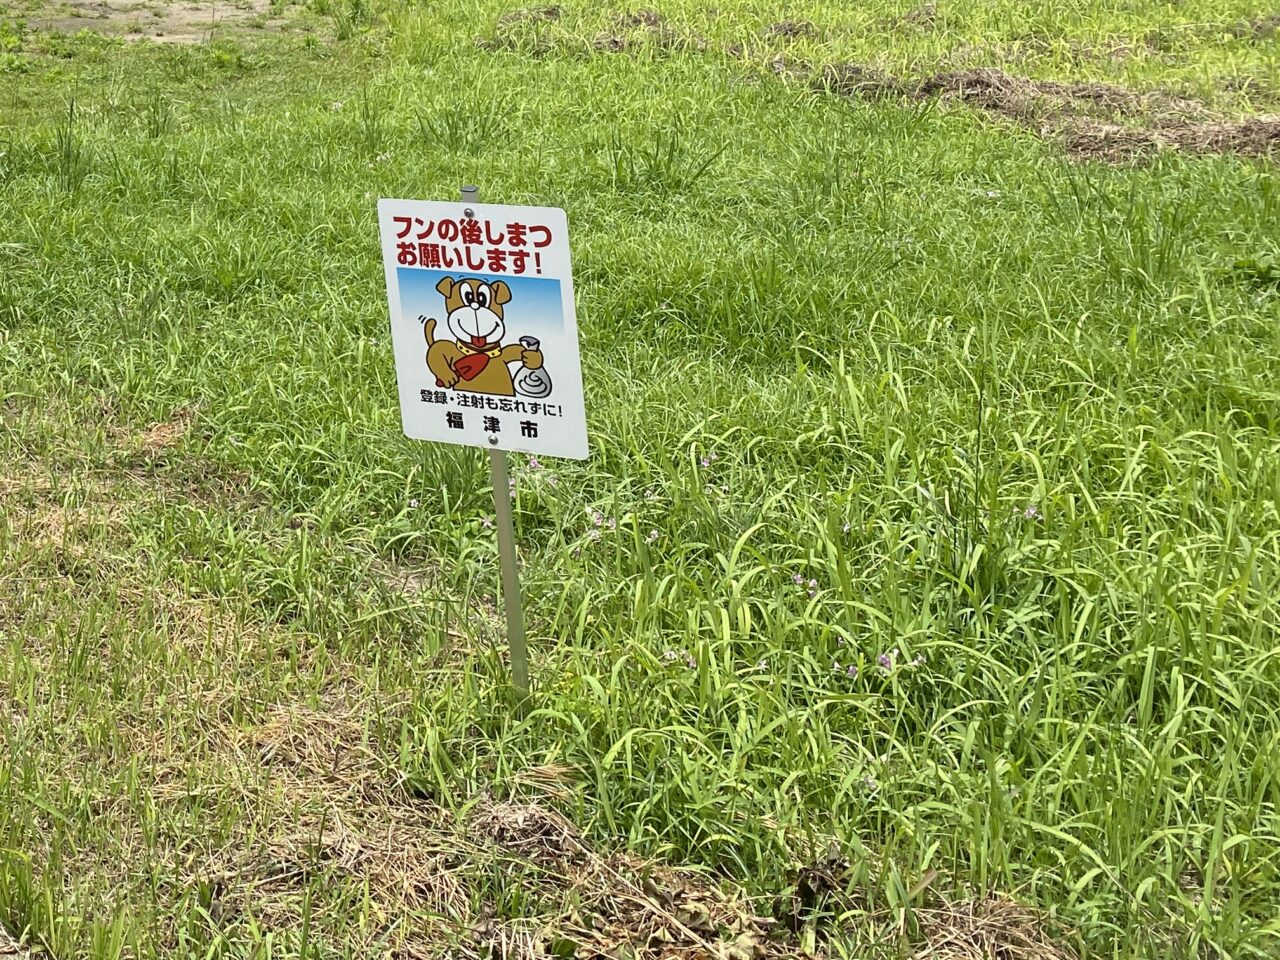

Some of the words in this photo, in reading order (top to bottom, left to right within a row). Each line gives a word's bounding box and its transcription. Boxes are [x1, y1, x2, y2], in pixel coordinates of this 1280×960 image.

[392, 216, 553, 248] フンの後しまつ
[446, 410, 538, 438] 福津市
